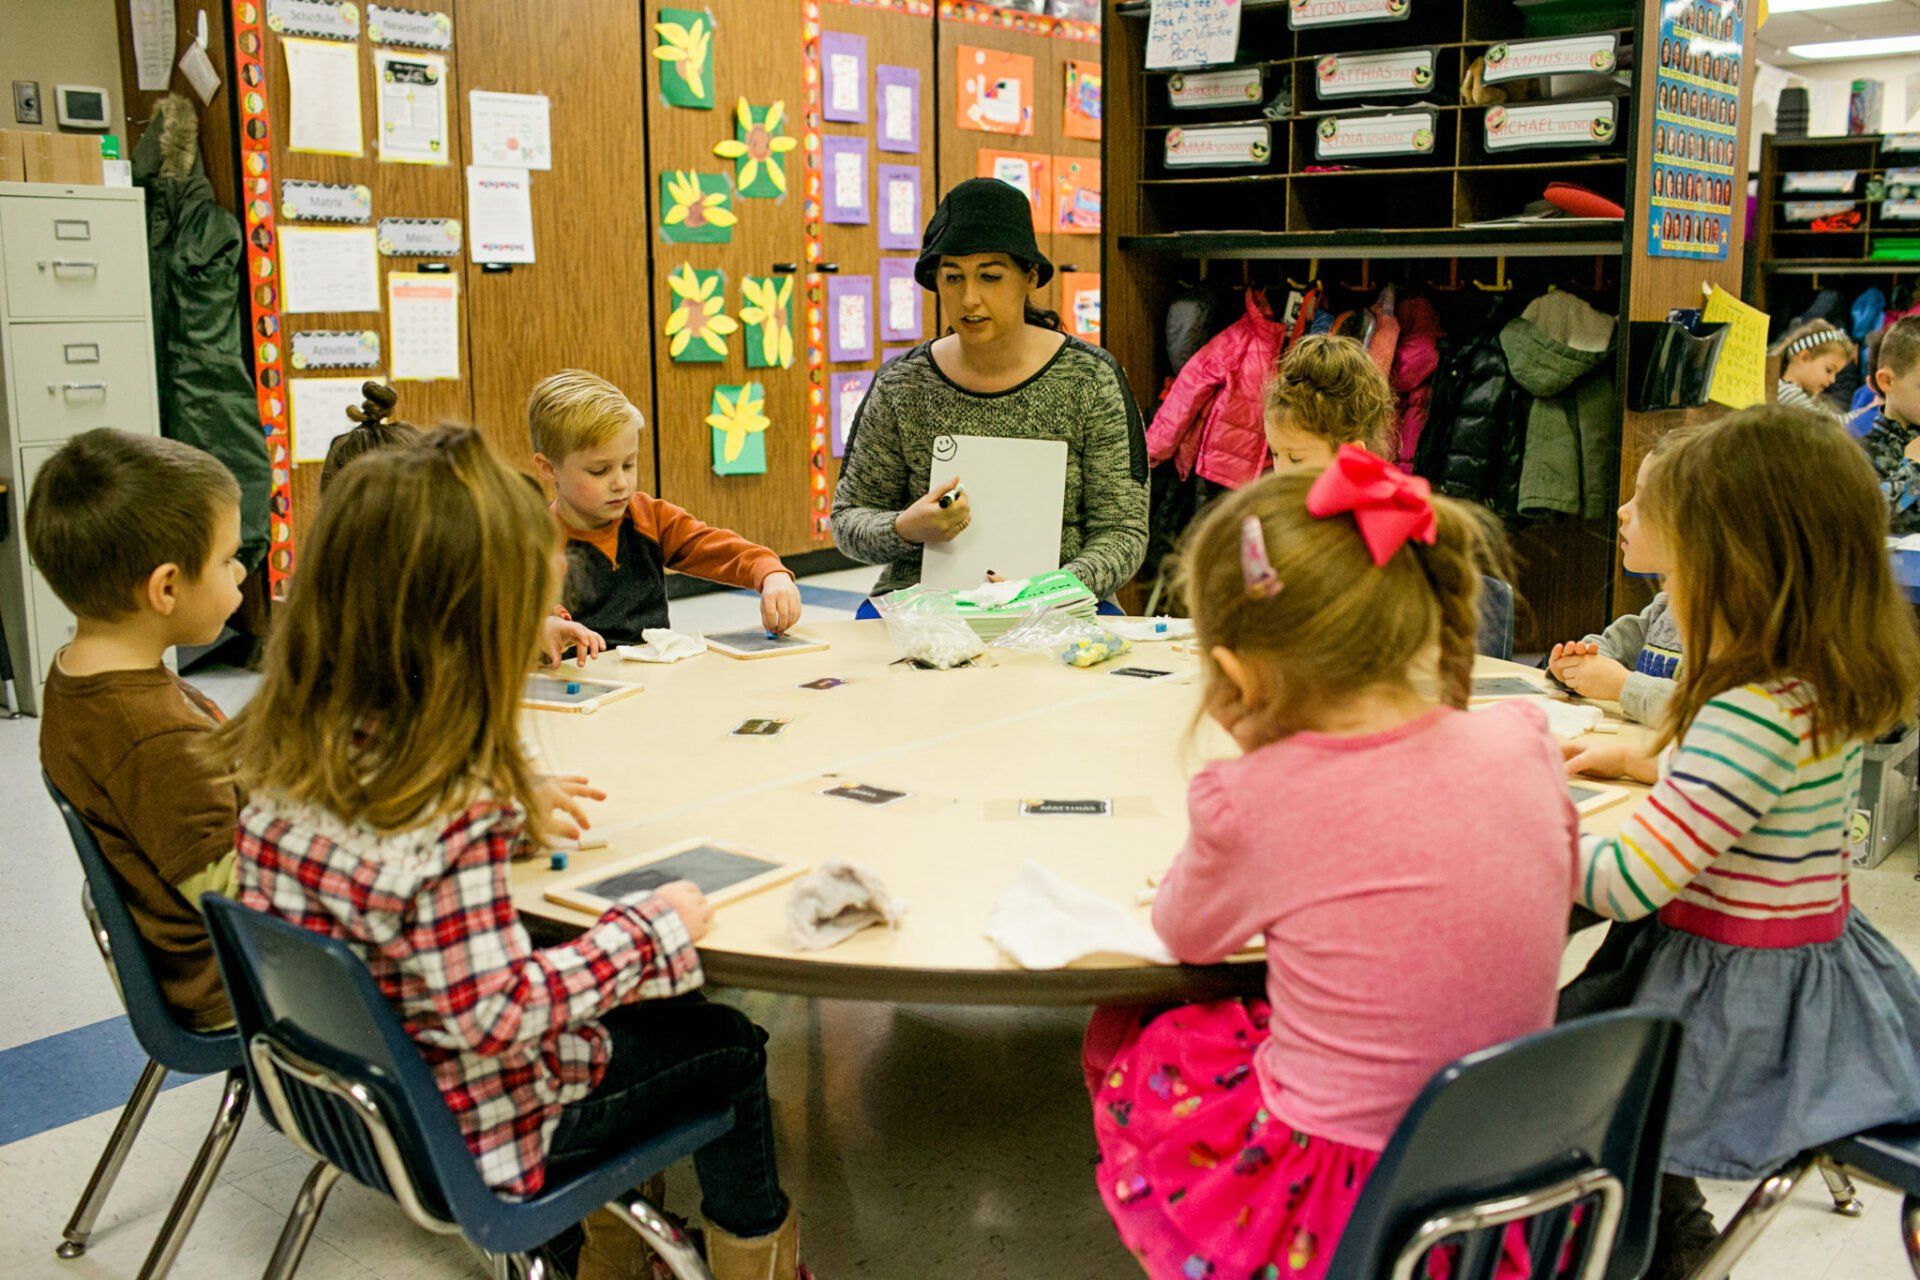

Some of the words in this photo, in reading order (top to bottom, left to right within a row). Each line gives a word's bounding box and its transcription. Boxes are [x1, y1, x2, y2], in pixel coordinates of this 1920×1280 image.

[289, 9, 336, 24] Schedule
[1326, 66, 1393, 83] ATTHIAS
[309, 196, 343, 208] Matrix
[405, 233, 433, 244] Menu
[312, 345, 357, 357] Activities
